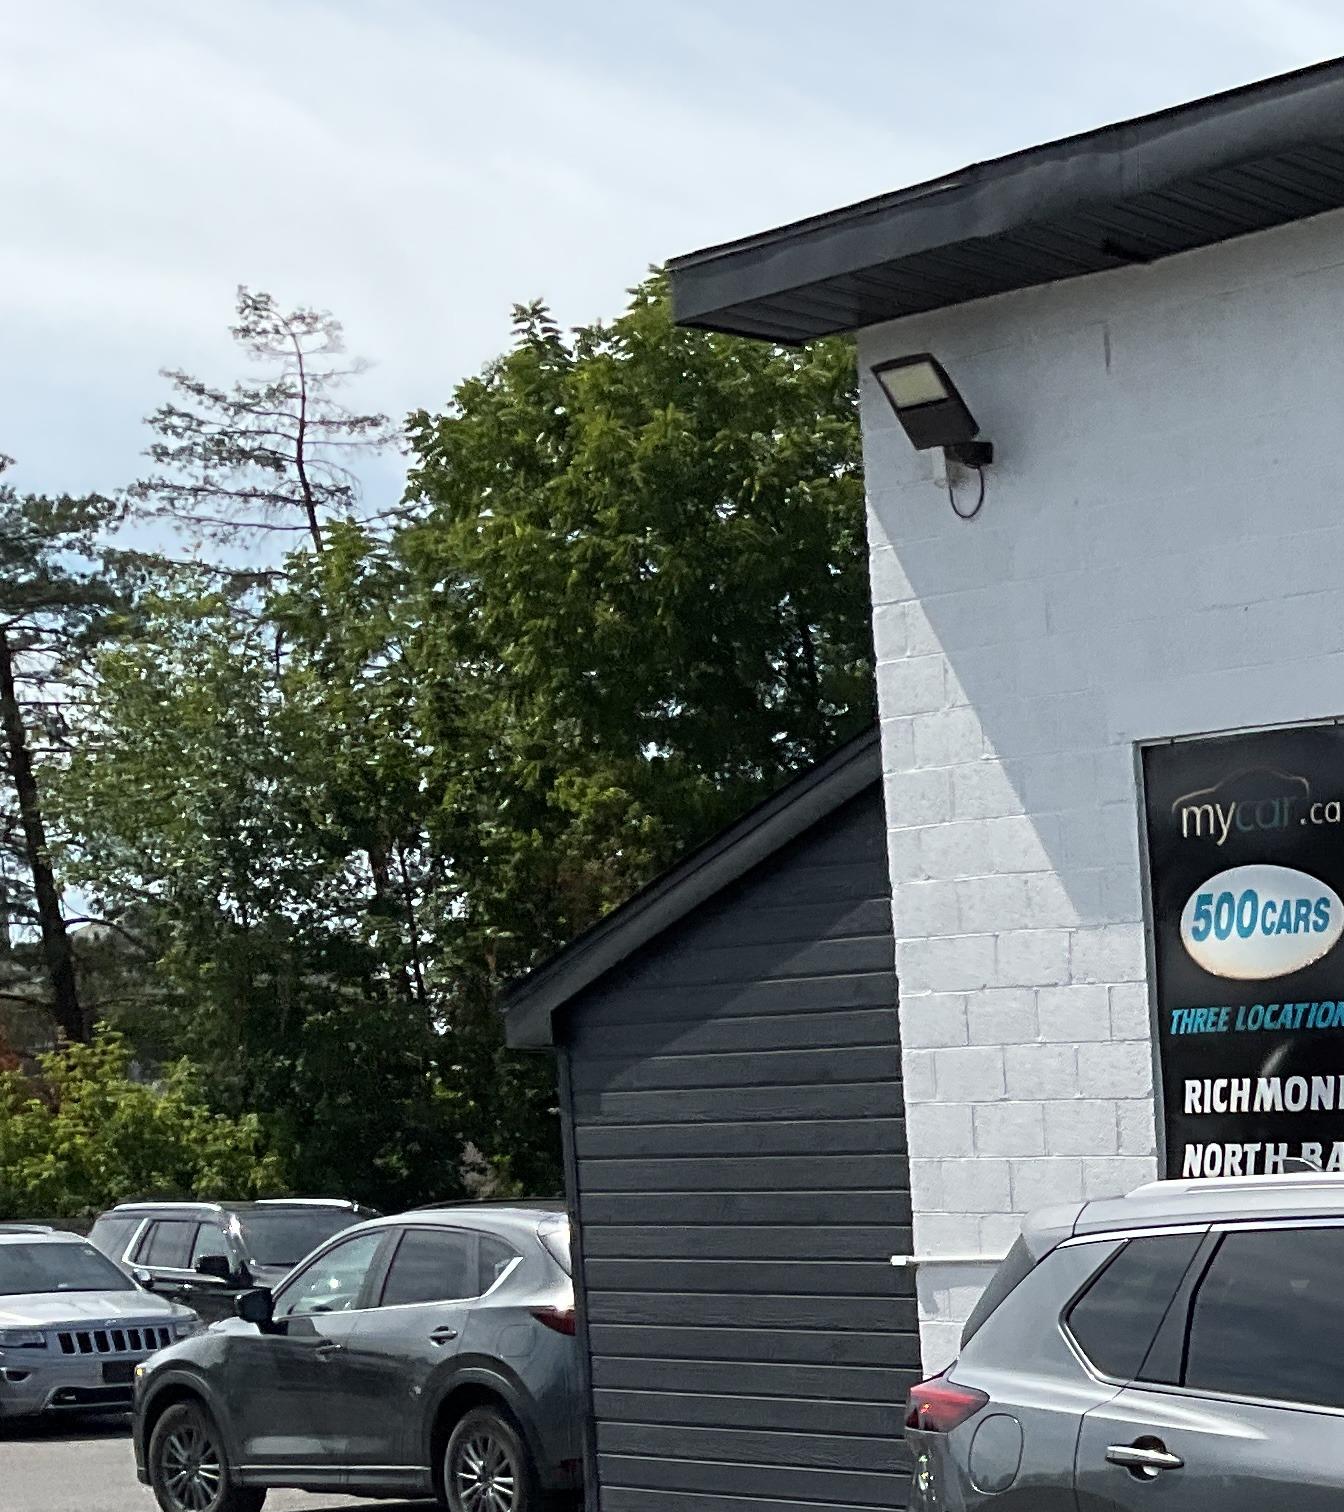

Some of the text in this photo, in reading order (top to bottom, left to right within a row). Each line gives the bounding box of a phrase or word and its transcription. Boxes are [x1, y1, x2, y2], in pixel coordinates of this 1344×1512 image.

[1181, 797, 1342, 846] mycar.ca
[1191, 889, 1331, 942] 500 CARS
[1170, 1006, 1229, 1035] THREE
[1182, 1142, 1288, 1178] NORTH
